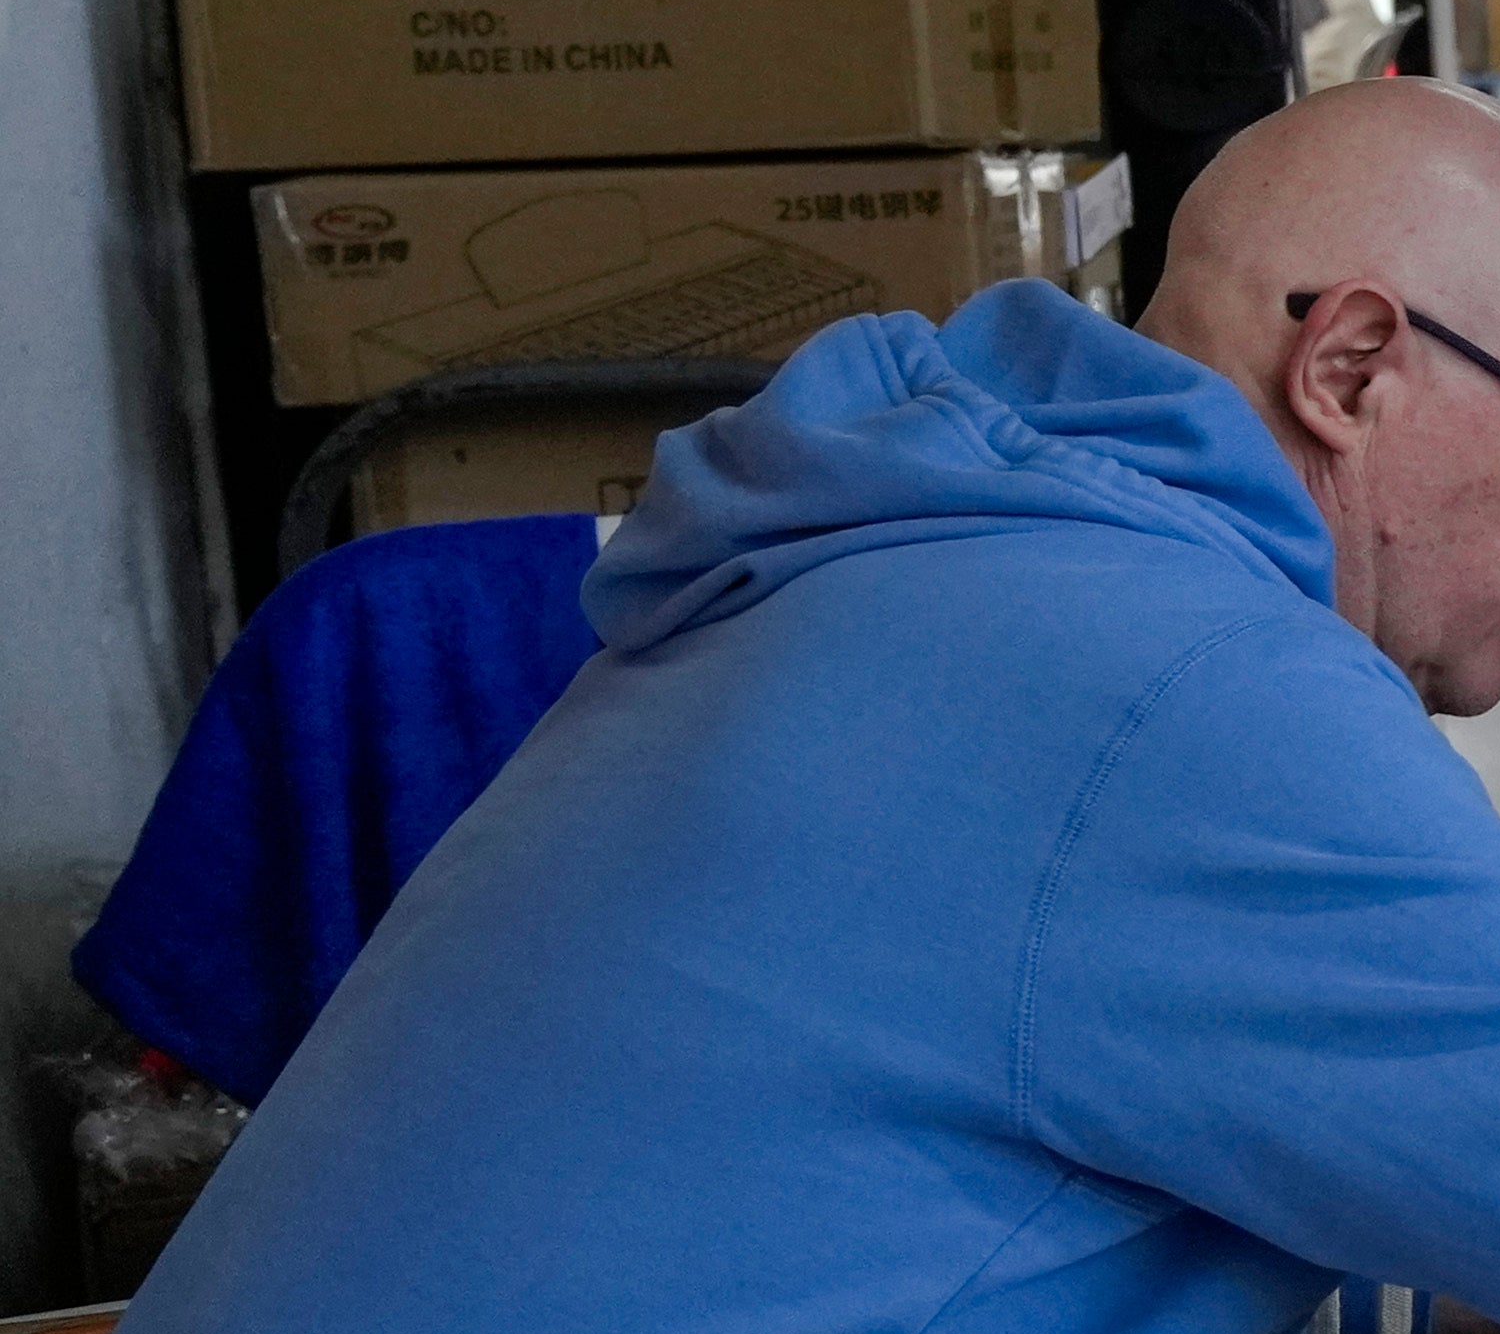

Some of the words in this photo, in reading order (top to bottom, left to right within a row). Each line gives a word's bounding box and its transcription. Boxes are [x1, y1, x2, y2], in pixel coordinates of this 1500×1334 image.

[412, 47, 512, 76] MADE
[520, 44, 555, 74] IN
[564, 41, 673, 72] CHINA
